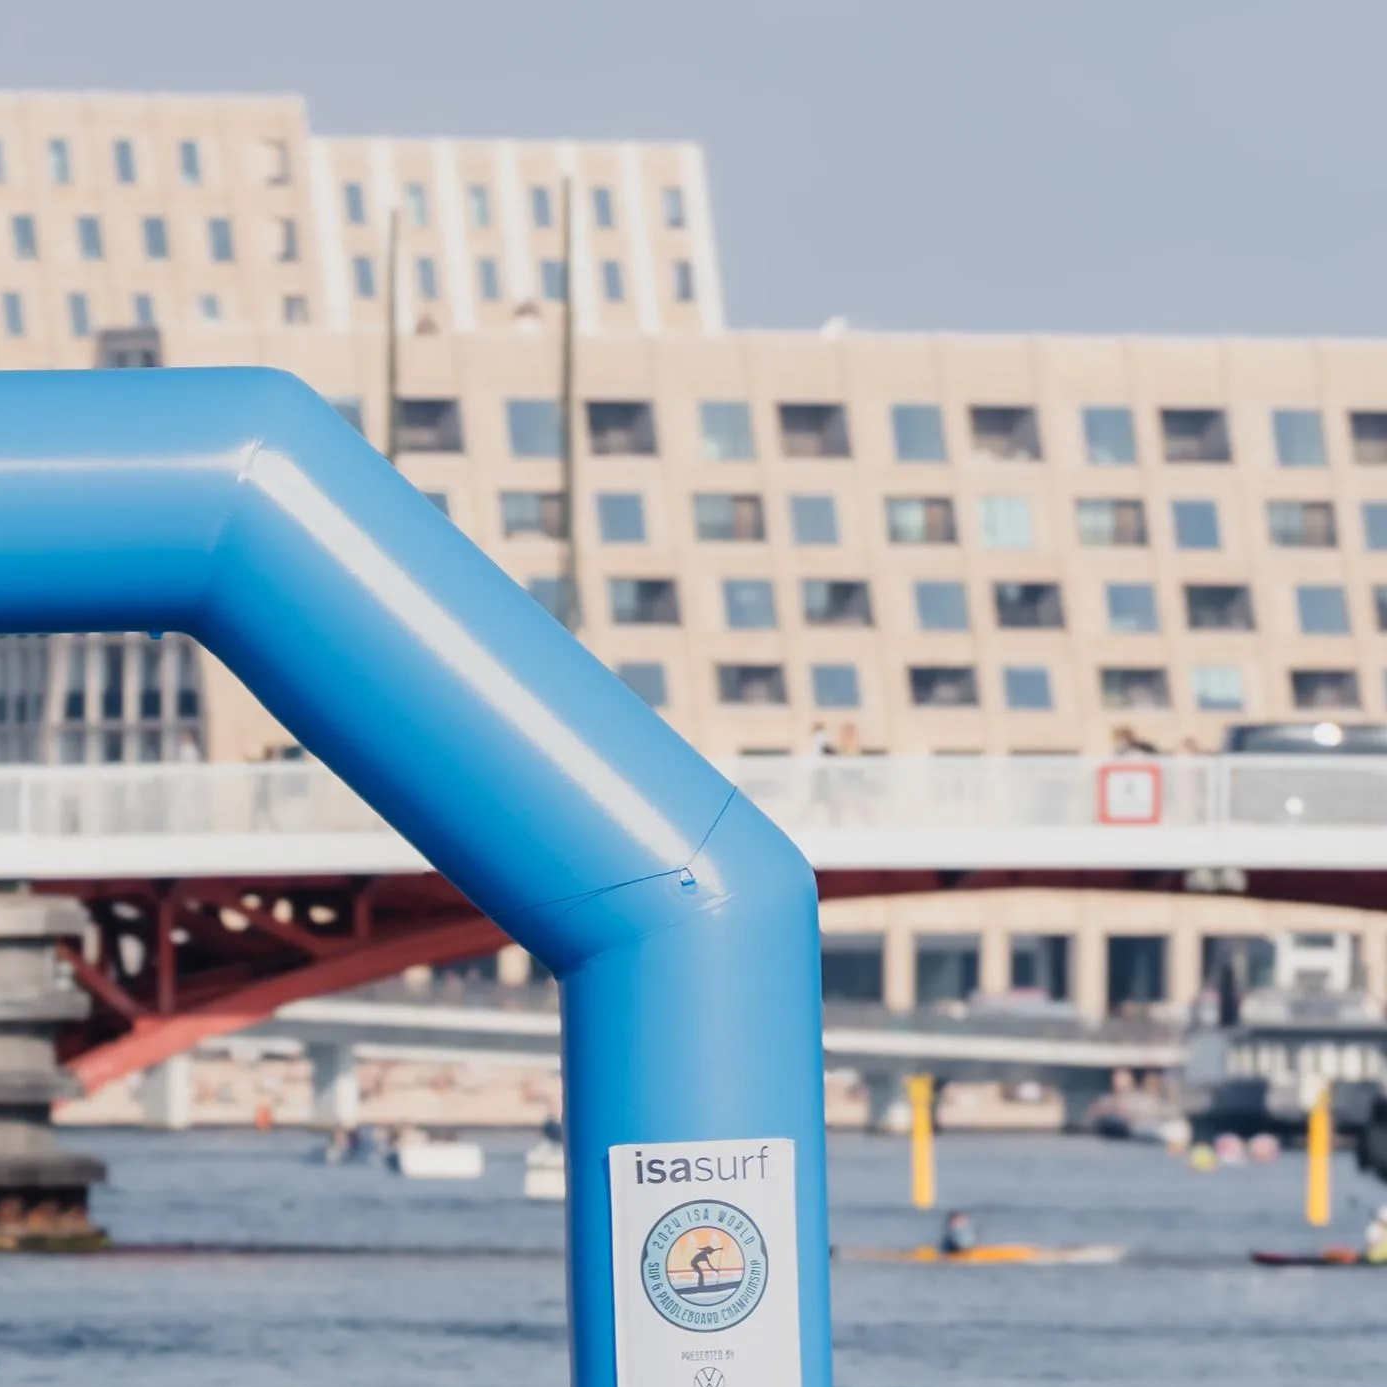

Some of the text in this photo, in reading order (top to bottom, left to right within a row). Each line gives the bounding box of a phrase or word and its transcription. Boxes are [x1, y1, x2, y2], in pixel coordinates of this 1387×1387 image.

[635, 1145, 769, 1185] isasurf
[652, 1208, 756, 1250] 2024 ISA WORLD
[648, 1259, 762, 1325] SUP & PADDLEBOARD CHAMPIONSHIP
